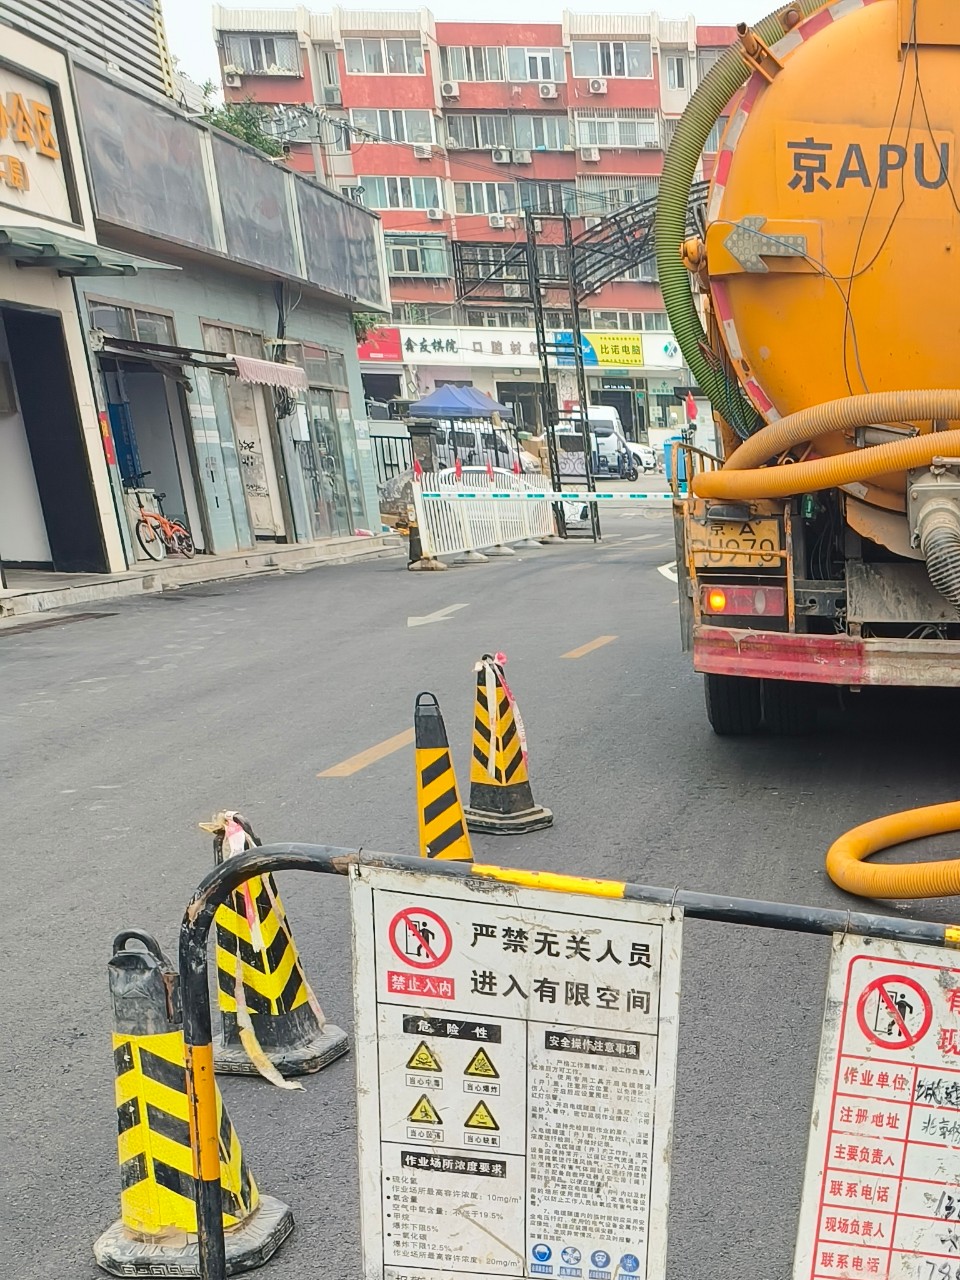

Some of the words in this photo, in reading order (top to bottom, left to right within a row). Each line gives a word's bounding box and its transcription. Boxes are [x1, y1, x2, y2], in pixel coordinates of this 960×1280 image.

[600, 344, 641, 355] 比诺电脑
[470, 922, 653, 969] 严禁无关人员
[391, 975, 452, 997] 禁止入内
[470, 969, 651, 1015] 进入有限空间
[549, 1035, 637, 1056] 安全操作注意事项
[466, 1082, 498, 1094] 当心爆炸
[843, 1066, 907, 1091] 作业单位
[839, 1106, 900, 1130] 注册地址
[467, 1135, 498, 1145] 当心缺氧
[404, 1154, 504, 1174] 作业场所浓度要求
[833, 1143, 895, 1167] 主要负责人
[392, 1175, 418, 1185] 硫化氢
[392, 1194, 418, 1204] 氧含量
[829, 1179, 891, 1203] 联系电话
[393, 1212, 410, 1221] 甲烷
[824, 1216, 885, 1238] 现场负责人
[392, 1222, 439, 1233] 爆炸下限5%
[393, 1232, 428, 1241] 一氧化碳
[820, 1251, 880, 1274] 联系电话
